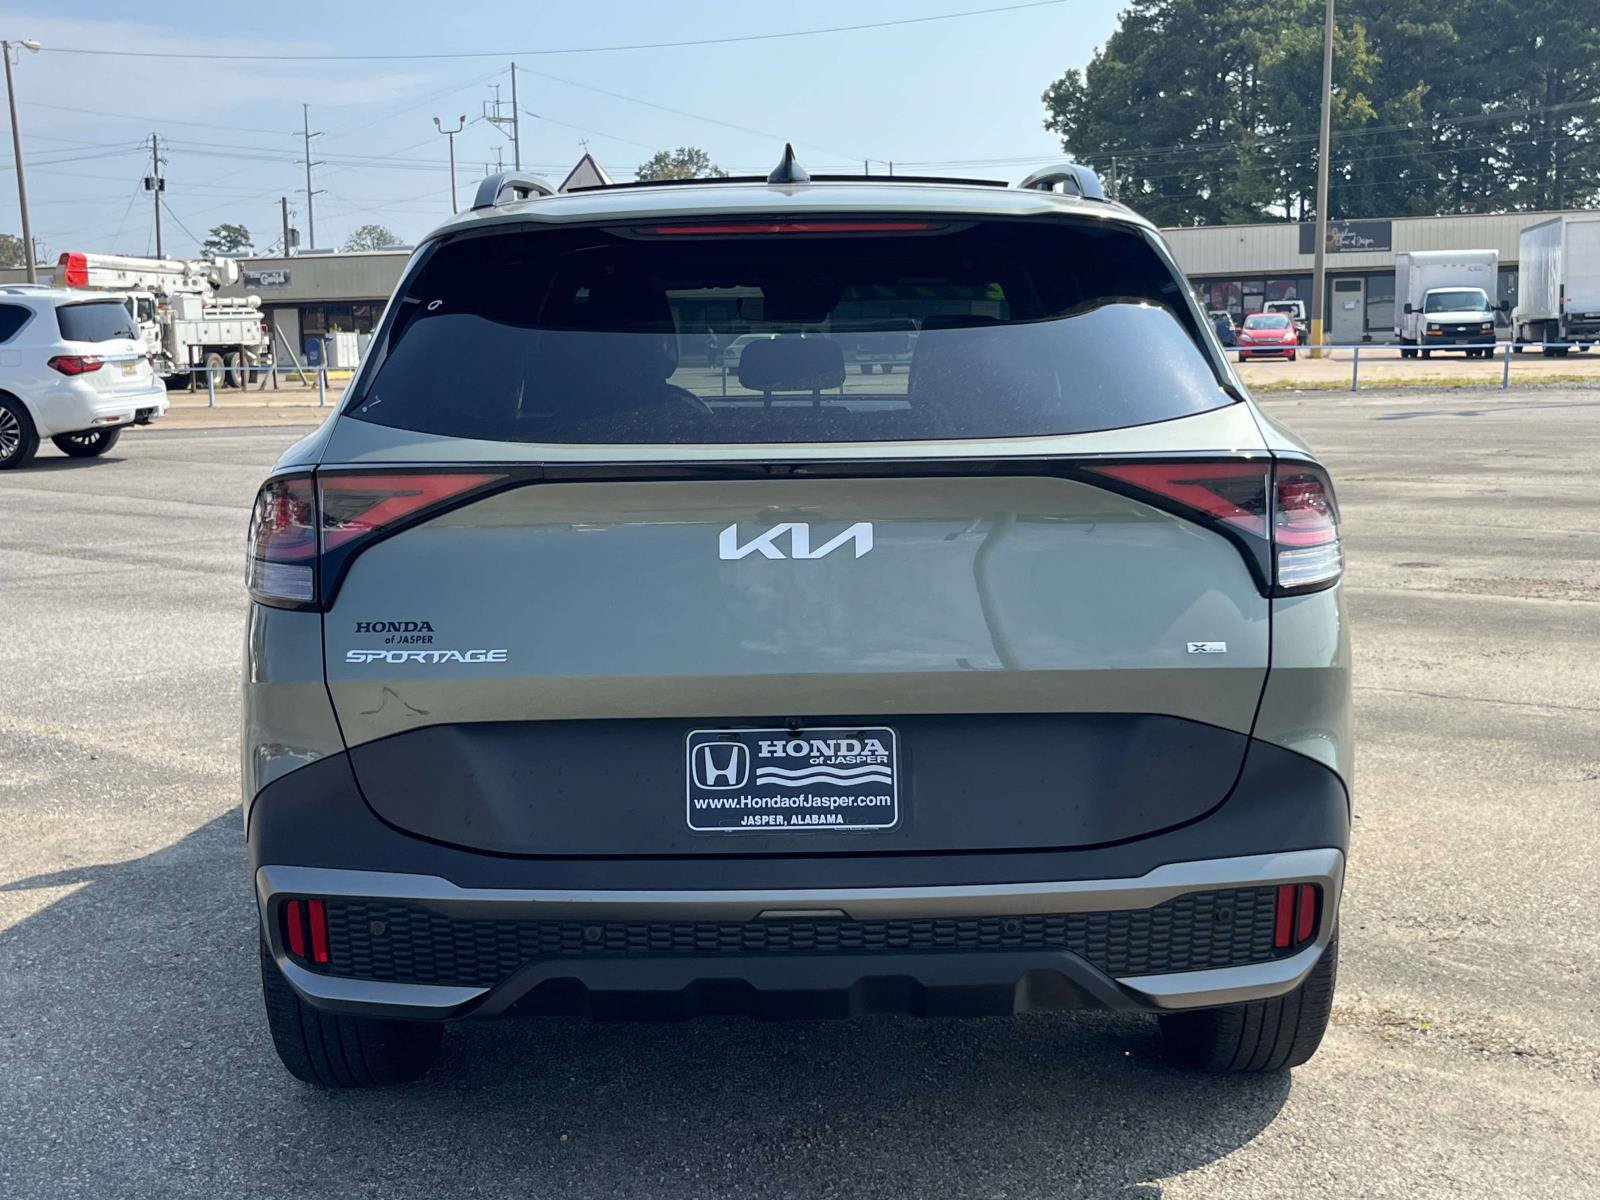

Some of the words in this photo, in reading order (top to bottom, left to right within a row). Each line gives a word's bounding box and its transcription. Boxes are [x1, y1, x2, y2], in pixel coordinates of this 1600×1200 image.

[719, 522, 874, 560] KIA
[354, 621, 435, 633] HONDA
[384, 635, 395, 644] of
[397, 635, 433, 644] JASPER
[345, 649, 508, 663] SPORTAGE
[758, 739, 889, 757] HONDA
[809, 756, 824, 765] of
[827, 755, 888, 764] JASPER
[694, 794, 891, 810] www.HondaofJasper.com
[741, 815, 787, 827] JASPER,
[790, 814, 844, 825] ALABAMA
